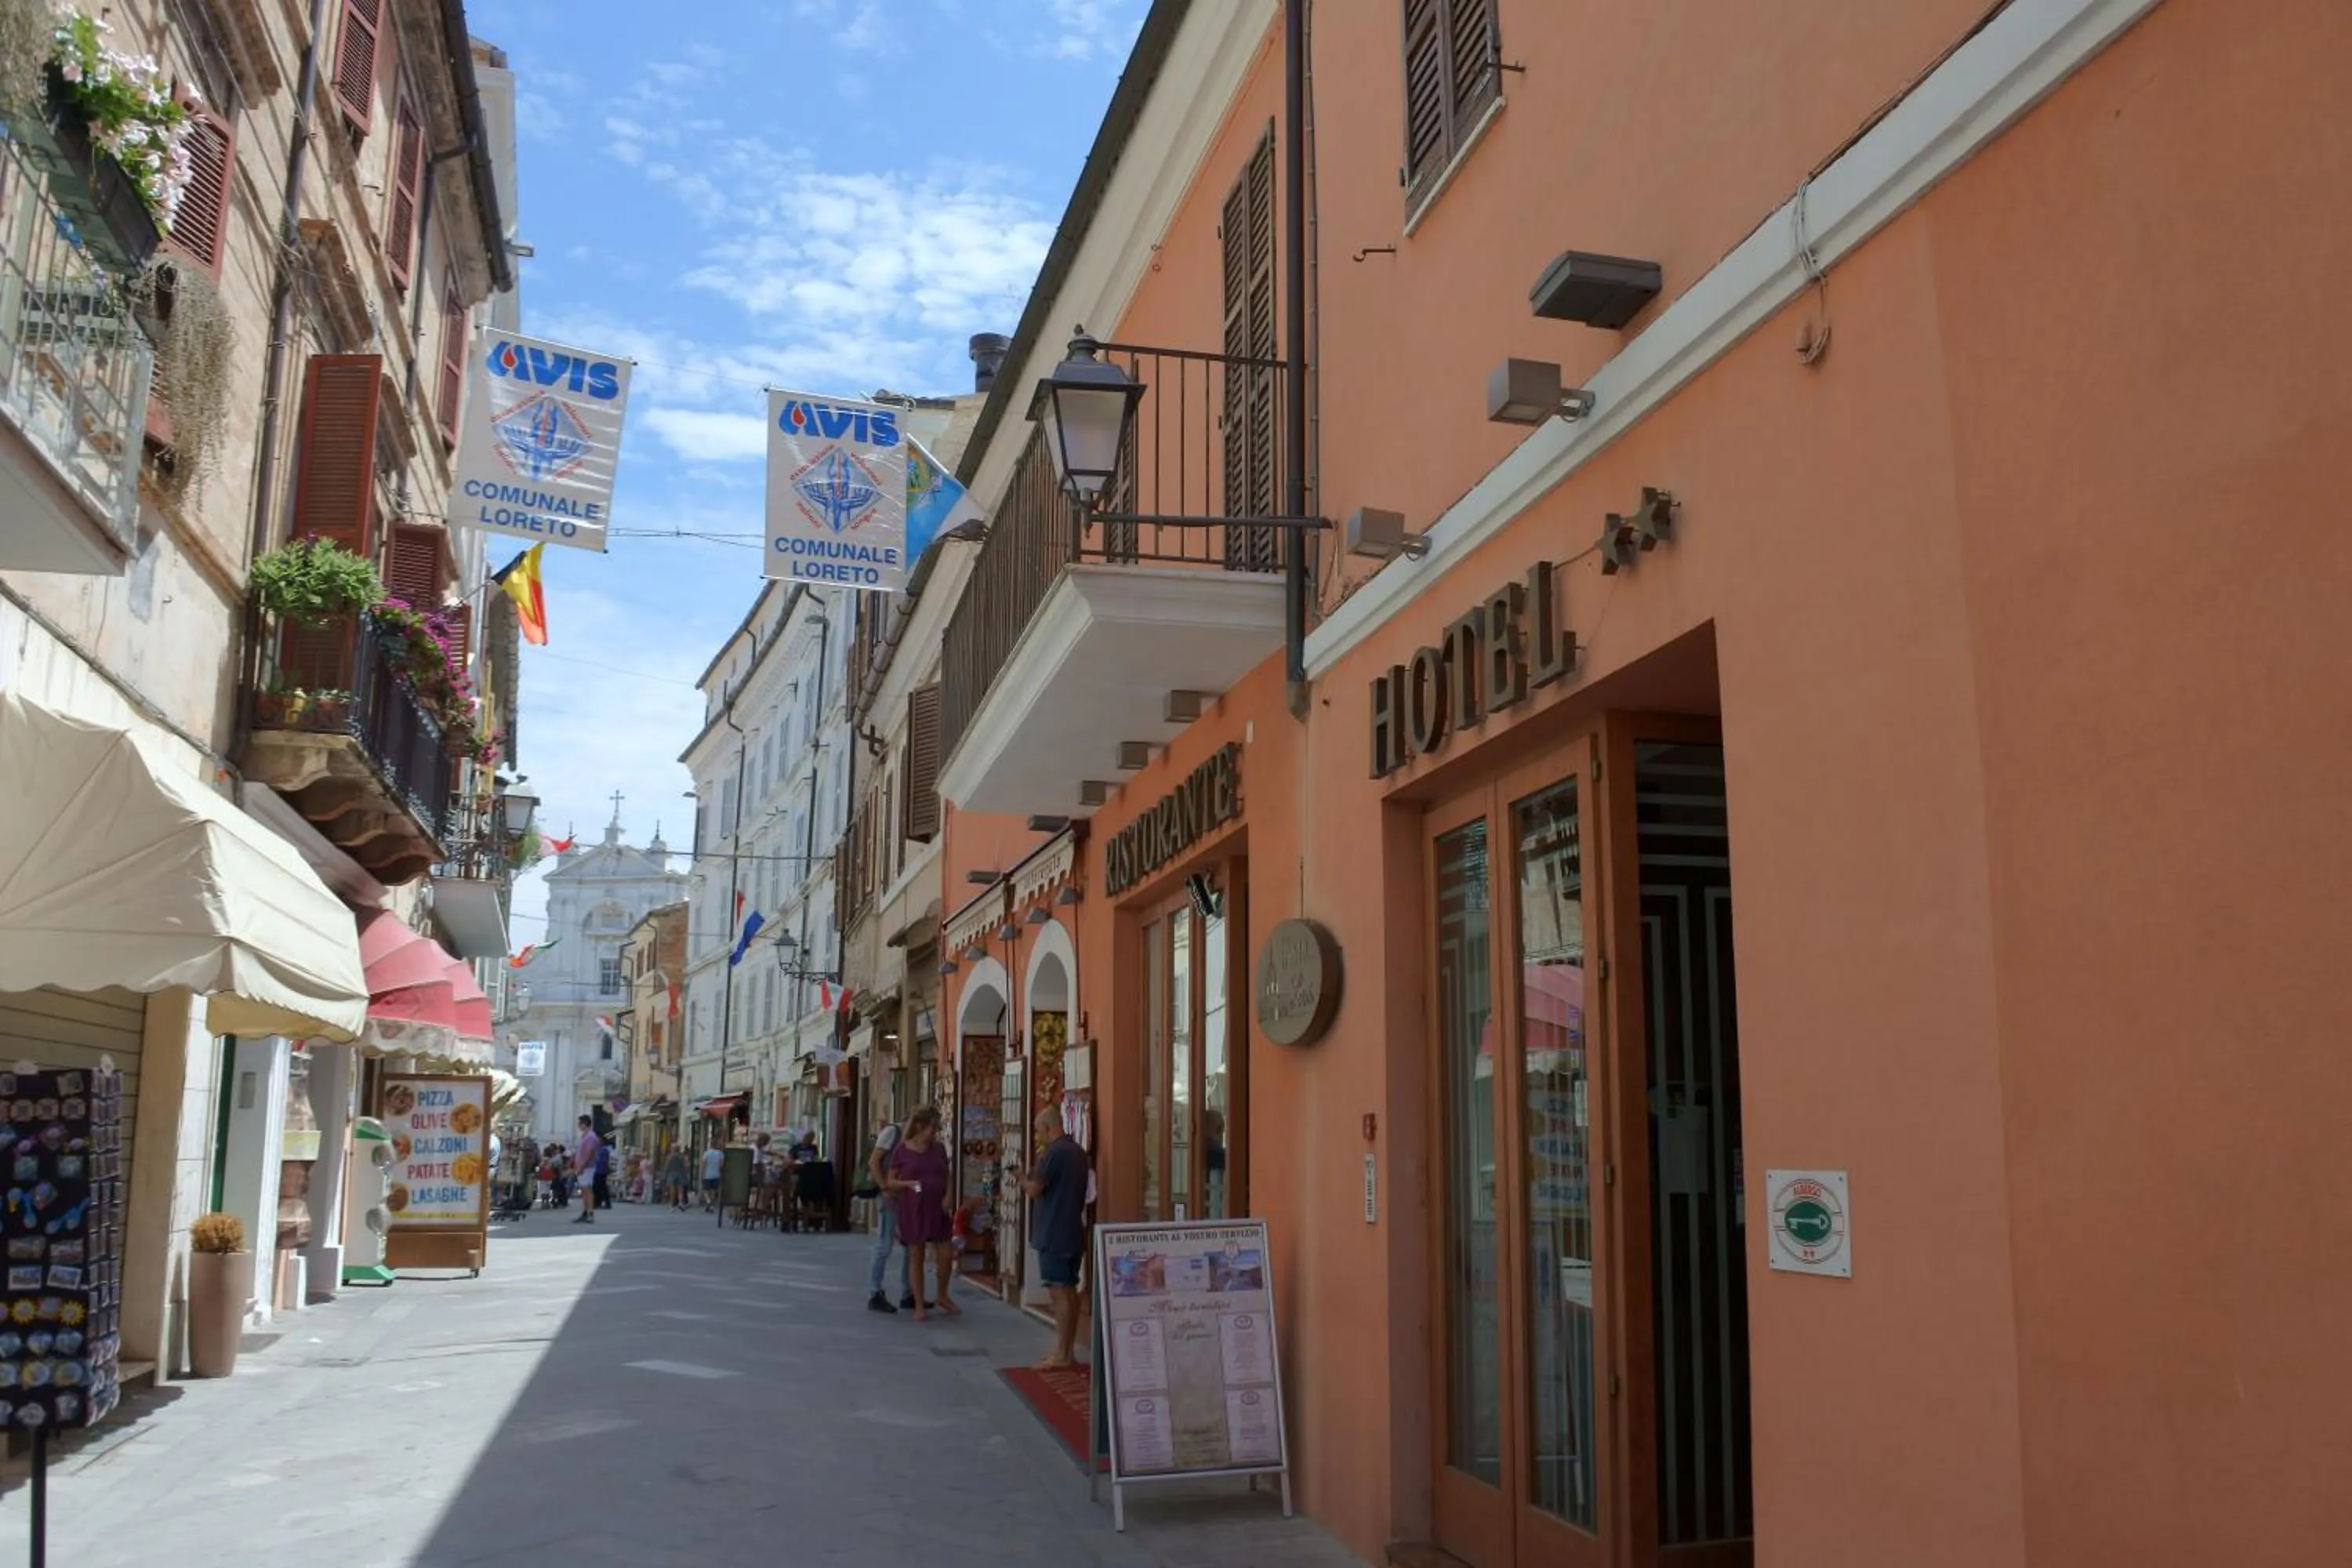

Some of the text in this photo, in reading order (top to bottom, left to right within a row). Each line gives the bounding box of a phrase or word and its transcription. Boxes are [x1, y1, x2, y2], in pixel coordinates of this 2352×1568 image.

[486, 341, 619, 400] AVIS
[779, 401, 899, 447] AVIS
[464, 480, 600, 520] COMUNALE
[480, 506, 576, 538] LORETO
[775, 537, 897, 564] COMUNALE
[793, 560, 879, 584] LORETO
[1370, 561, 1577, 779] HOTEL
[1105, 742, 1240, 898] RISTORANTE
[417, 1091, 454, 1106] PIZZA
[412, 1112, 448, 1129] OLIVE
[414, 1136, 468, 1154] CALZONI
[407, 1162, 450, 1180] PATATE
[411, 1187, 468, 1204] LASAGNE
